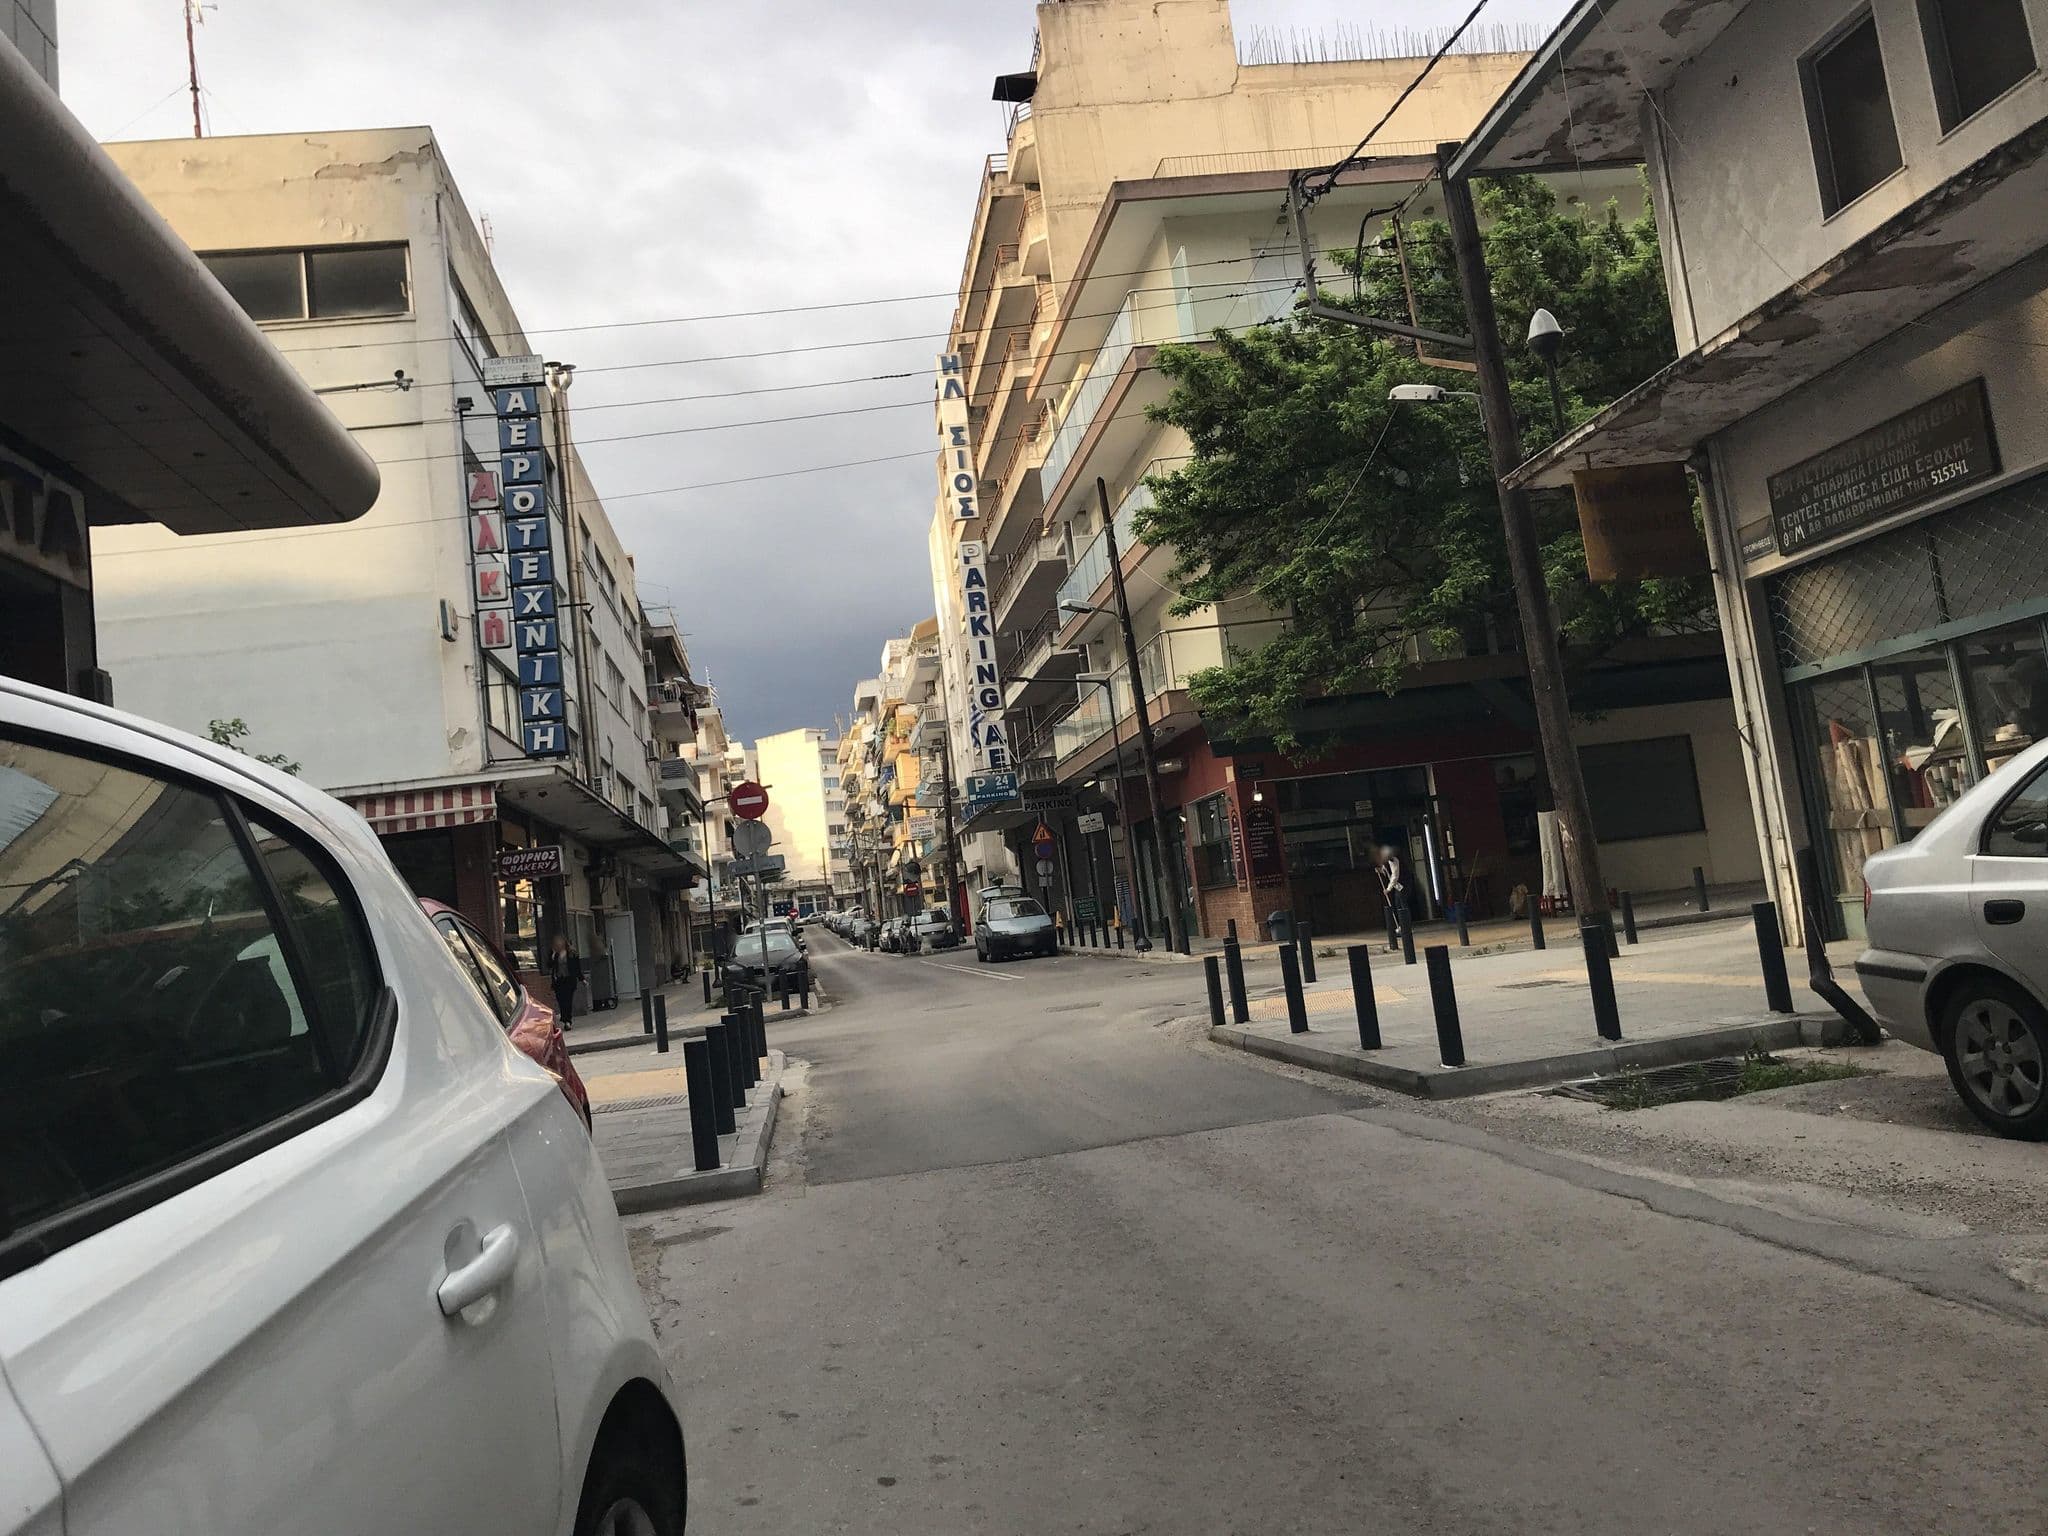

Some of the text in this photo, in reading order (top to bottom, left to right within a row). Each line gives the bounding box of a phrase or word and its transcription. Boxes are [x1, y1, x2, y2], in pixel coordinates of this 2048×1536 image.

[1881, 463, 1910, 488] ΕΙΔΗ
[1915, 436, 1973, 474] ΕΞΟΧΗΣ
[506, 391, 555, 751] ΑΕΡΟΤΕΧΝΙΚΗ
[962, 544, 999, 708] PARKING
[974, 778, 986, 792] P
[995, 775, 1009, 786] 24
[977, 791, 1009, 799] PARKING
[1024, 799, 1072, 811] PARKING
[502, 850, 557, 865] ΦΟΥΡΝΟΣ
[510, 861, 551, 873] BAKERY
